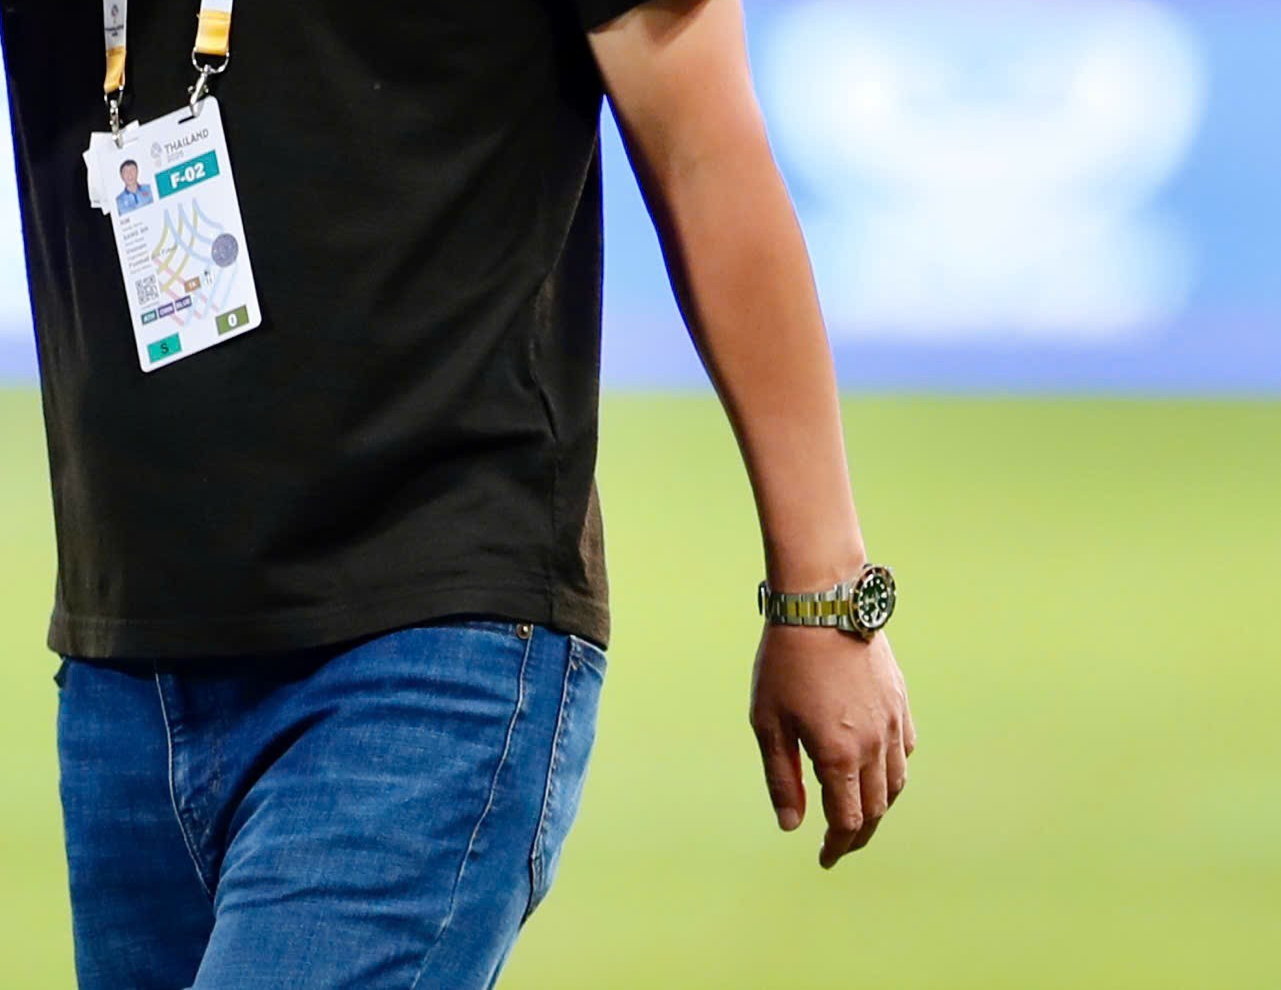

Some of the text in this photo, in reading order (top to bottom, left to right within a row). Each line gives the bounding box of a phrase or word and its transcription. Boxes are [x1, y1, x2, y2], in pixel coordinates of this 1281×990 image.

[164, 128, 209, 155] THAILAND
[170, 162, 206, 189] F-02
[160, 342, 169, 354] S
